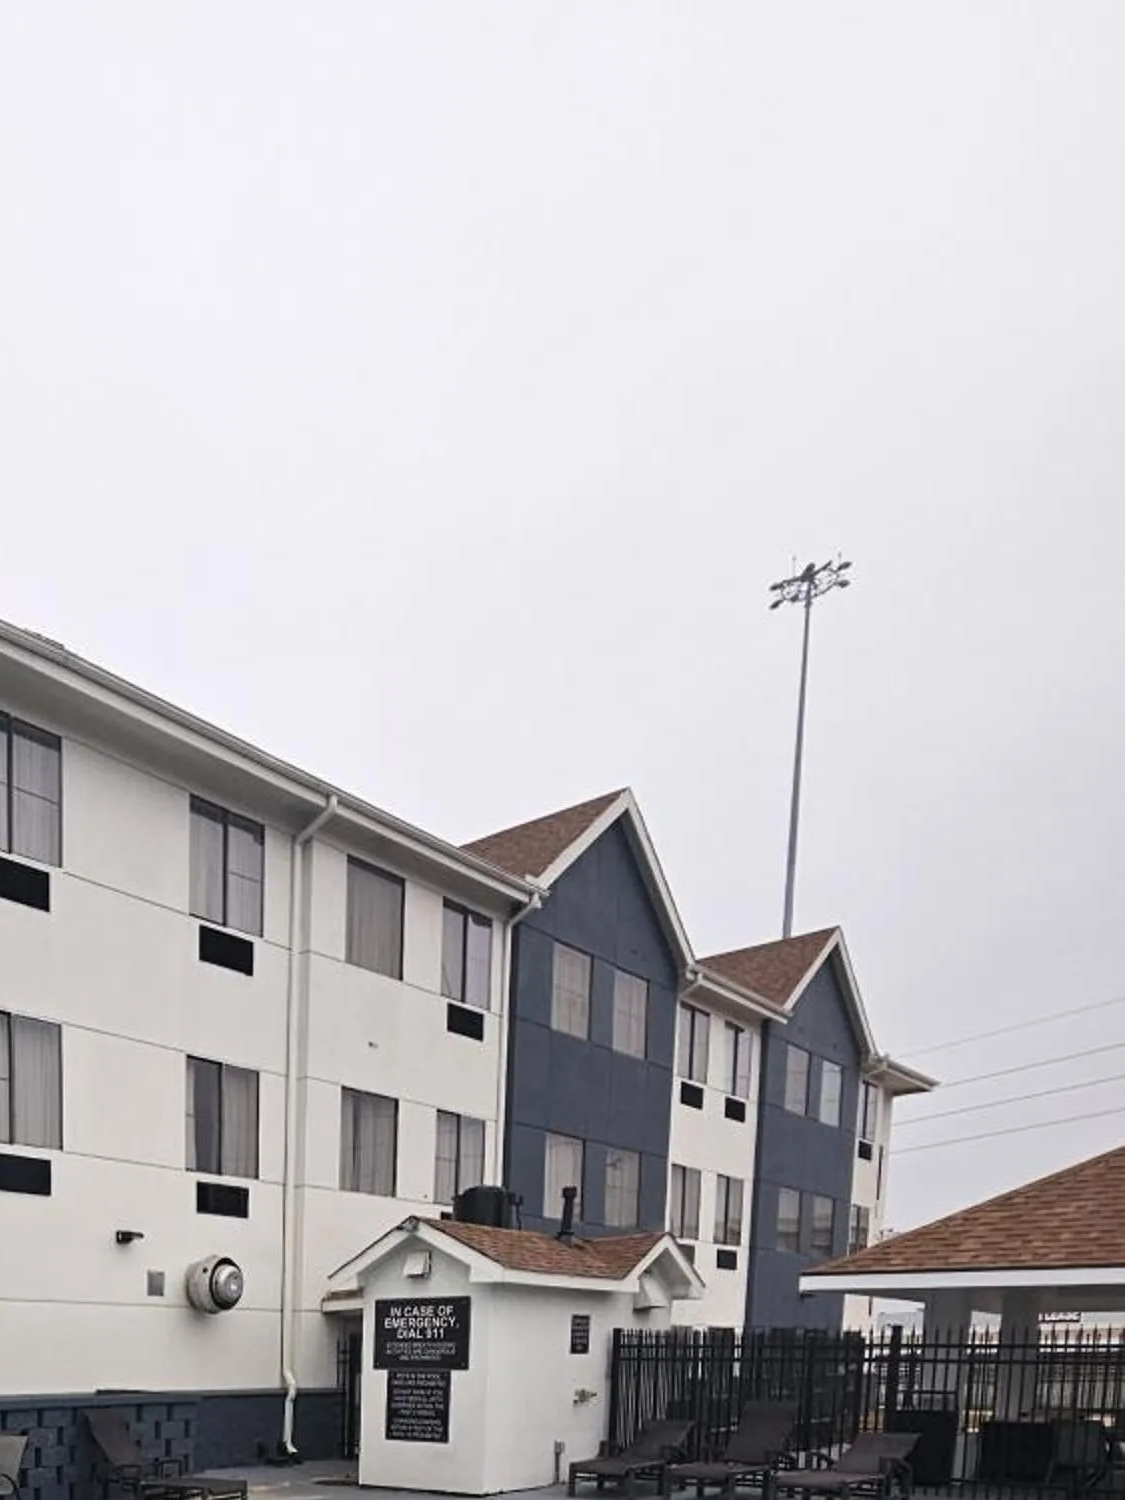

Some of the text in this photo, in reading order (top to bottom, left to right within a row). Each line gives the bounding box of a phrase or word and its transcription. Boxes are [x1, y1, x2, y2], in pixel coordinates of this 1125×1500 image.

[390, 1305, 454, 1317] IN CASE OF
[397, 1328, 423, 1339] DIAL
